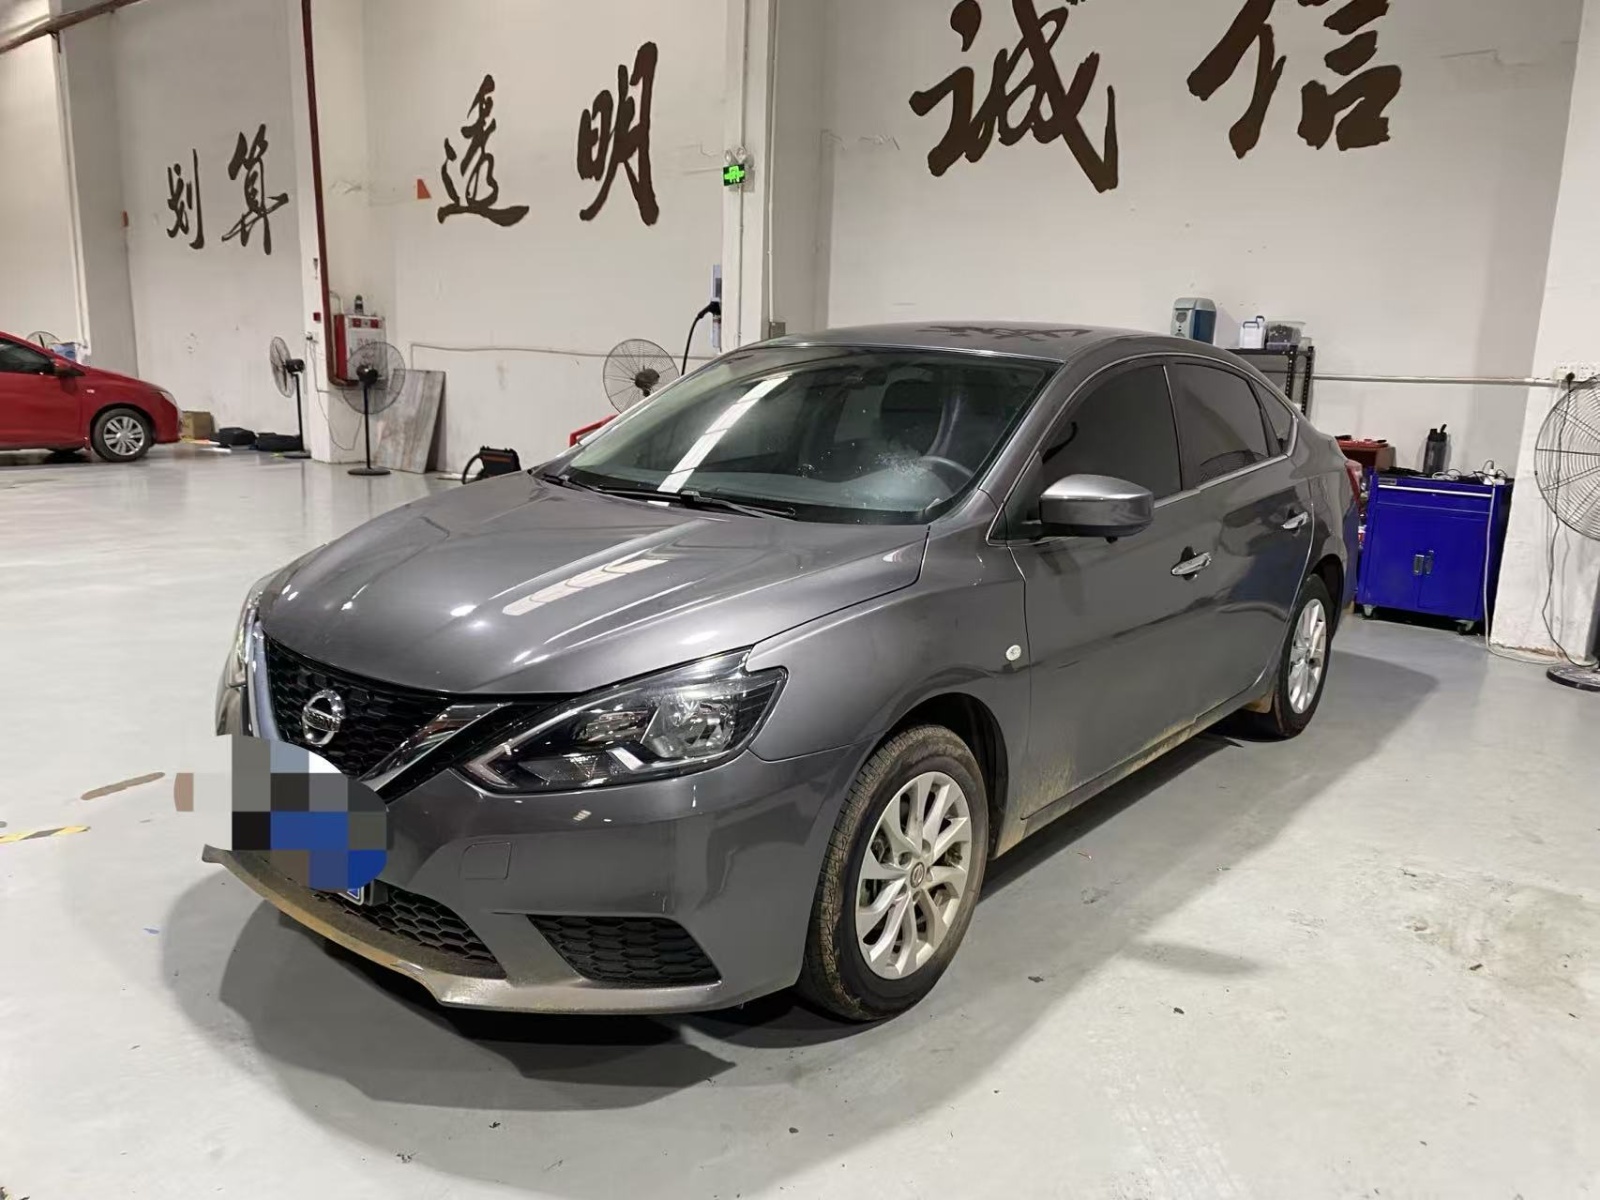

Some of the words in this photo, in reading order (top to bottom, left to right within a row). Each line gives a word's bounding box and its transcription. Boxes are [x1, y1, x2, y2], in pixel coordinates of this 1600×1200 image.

[166, 123, 289, 256] 划算
[437, 41, 660, 227] 透明
[908, 0, 1403, 194] 诚信
